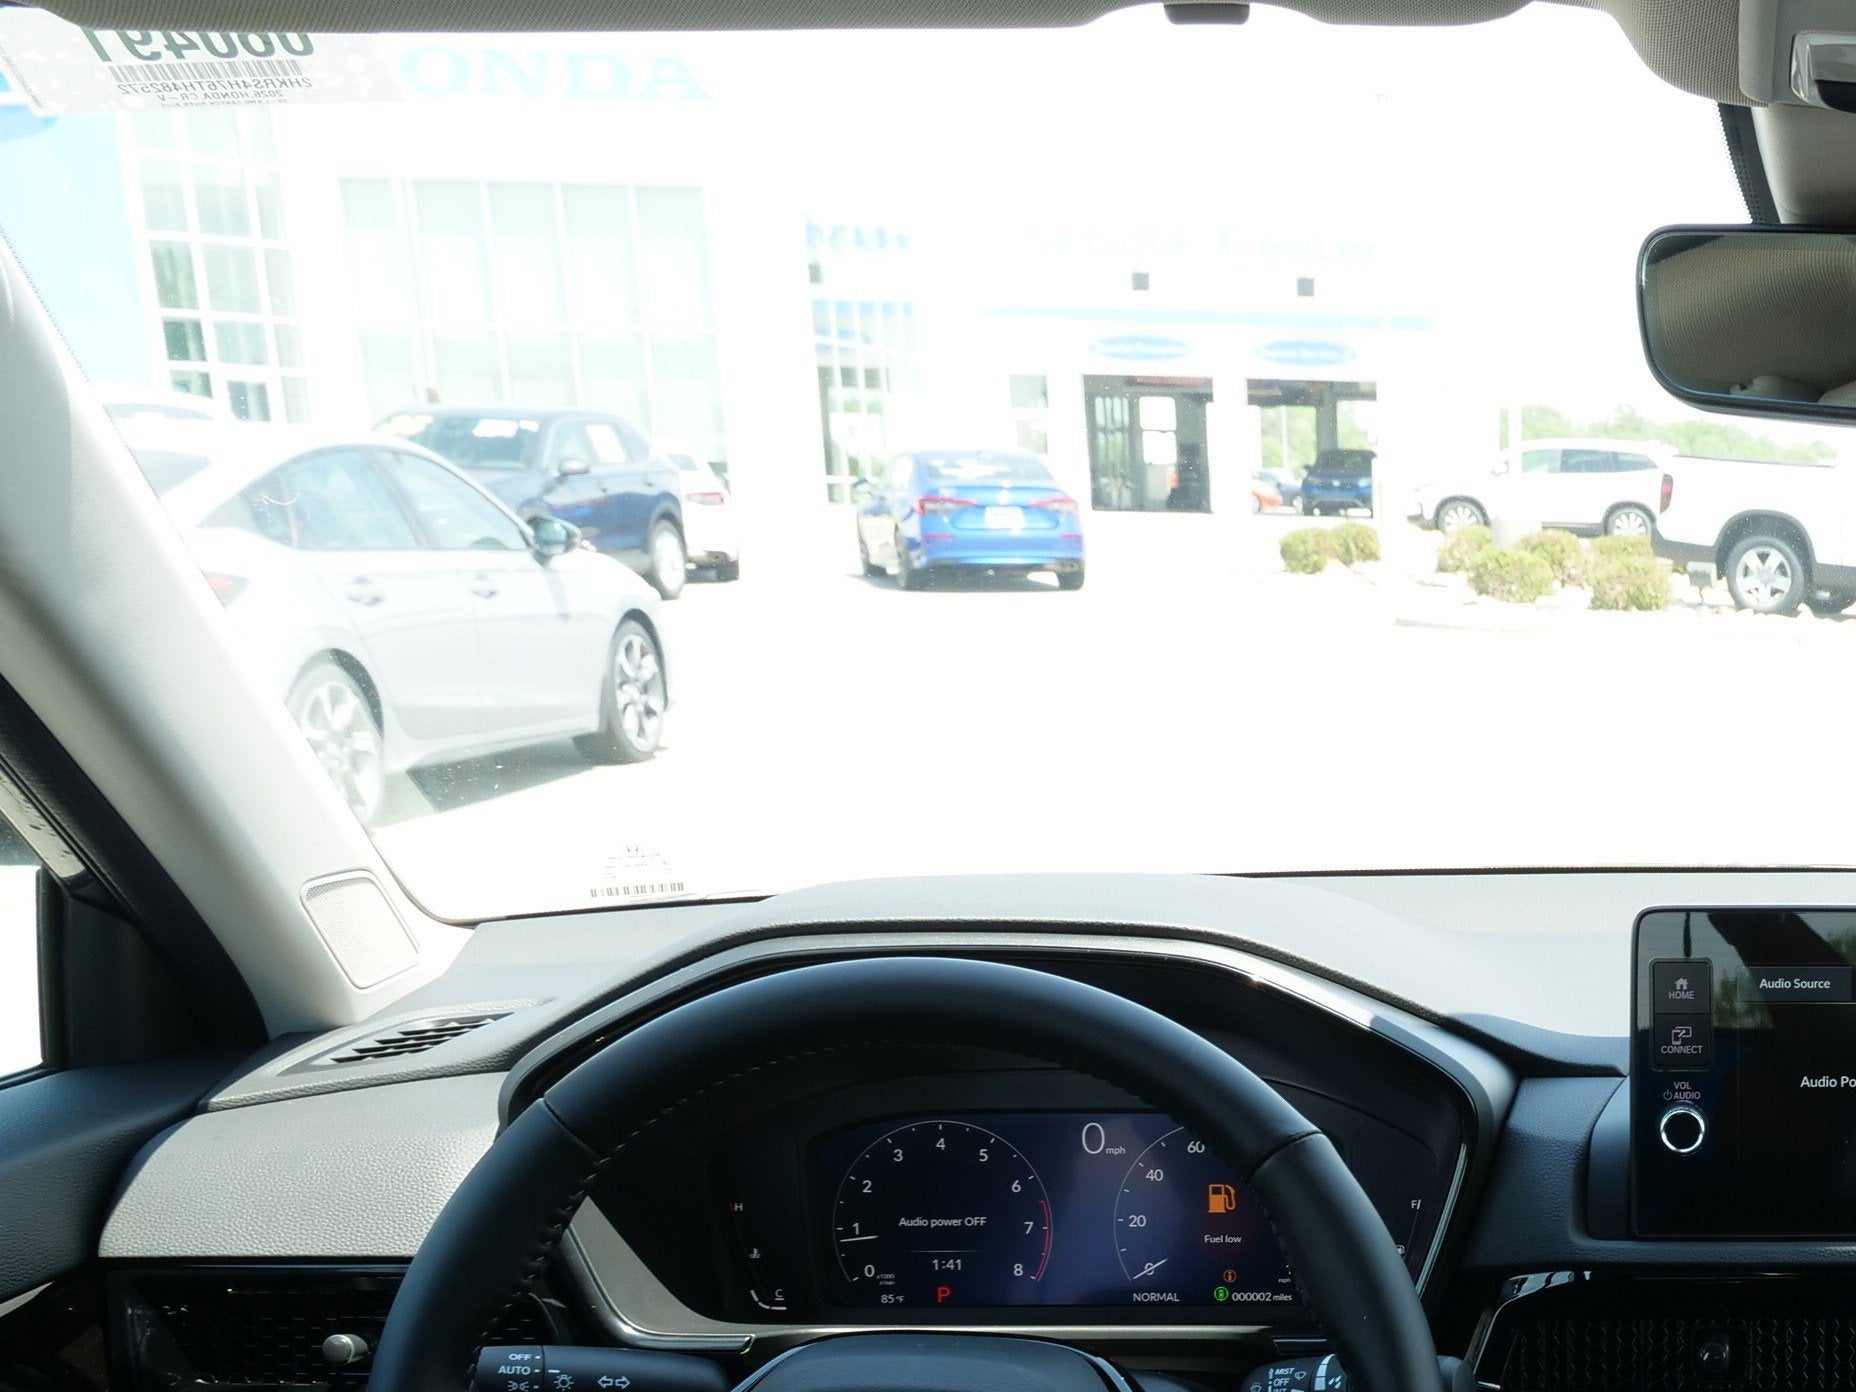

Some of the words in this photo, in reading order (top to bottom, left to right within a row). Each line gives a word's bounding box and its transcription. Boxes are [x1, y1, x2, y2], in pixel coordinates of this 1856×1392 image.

[398, 44, 714, 102] ONDA
[1759, 978, 1791, 989] Audio
[1793, 978, 1831, 989] Source
[1668, 991, 1695, 1000] HOME
[1660, 1045, 1703, 1054] CONNECT
[1673, 1081, 1692, 1090] VOL
[1800, 1075, 1837, 1088] Audio
[1673, 1091, 1701, 1100] AUDIO
[936, 1138, 946, 1150] 4
[1082, 1122, 1105, 1154] 0
[1105, 1147, 1126, 1156] mph
[1187, 1141, 1205, 1153] 60
[893, 1149, 904, 1162] 3
[979, 1149, 989, 1162] 5
[1146, 1169, 1164, 1181] 40
[862, 1180, 872, 1193] 2
[1011, 1180, 1022, 1193] 6
[734, 1202, 743, 1212] H
[898, 1217, 928, 1227] Audio
[930, 1218, 962, 1228] power
[964, 1217, 987, 1226] OFF
[1129, 1215, 1146, 1227] 20
[852, 1222, 860, 1235] 1
[1024, 1222, 1034, 1234] 7
[1204, 1235, 1223, 1243] Fuel
[1225, 1235, 1242, 1243] low
[864, 1264, 875, 1277] 0
[932, 1259, 962, 1271] 1:41
[1013, 1264, 1023, 1276] 8
[937, 1286, 952, 1303] P
[1133, 1293, 1180, 1302] NORMAL
[1231, 1292, 1272, 1301] 000002
[498, 1365, 531, 1375] AUTO
[1273, 1378, 1290, 1387] OFF
